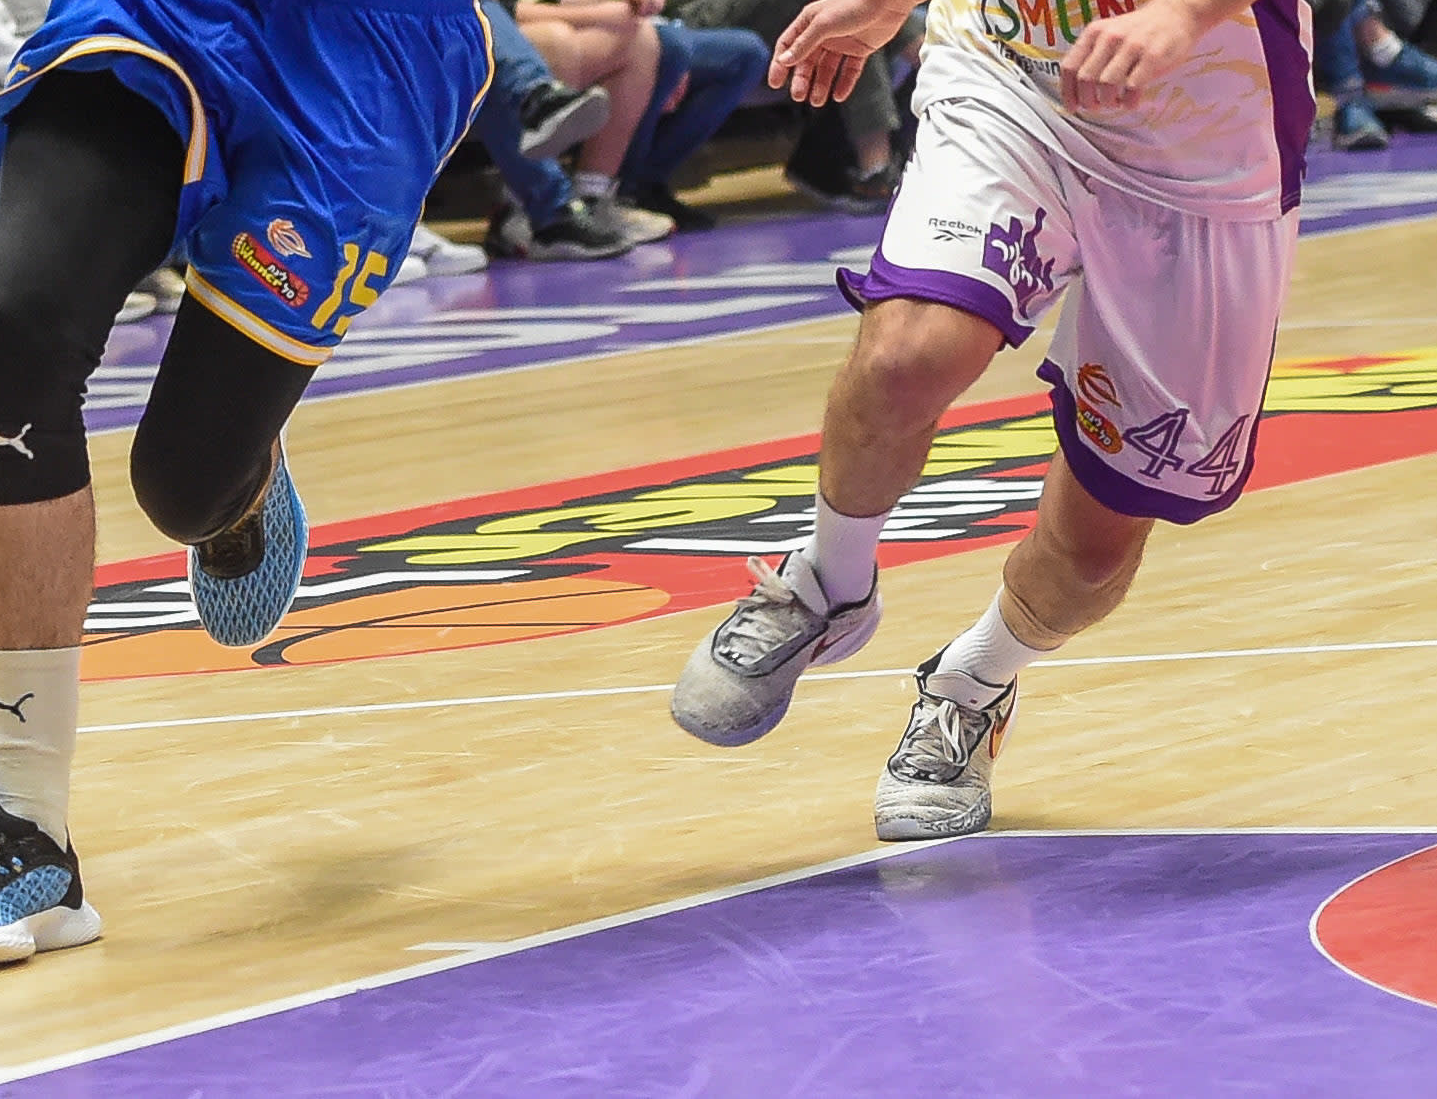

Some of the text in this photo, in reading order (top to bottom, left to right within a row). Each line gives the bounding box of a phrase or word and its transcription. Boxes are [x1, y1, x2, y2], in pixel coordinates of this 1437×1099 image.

[928, 217, 983, 236] Reebok
[238, 241, 283, 288] Winner
[311, 242, 388, 337] 15
[1122, 407, 1251, 496] 44
